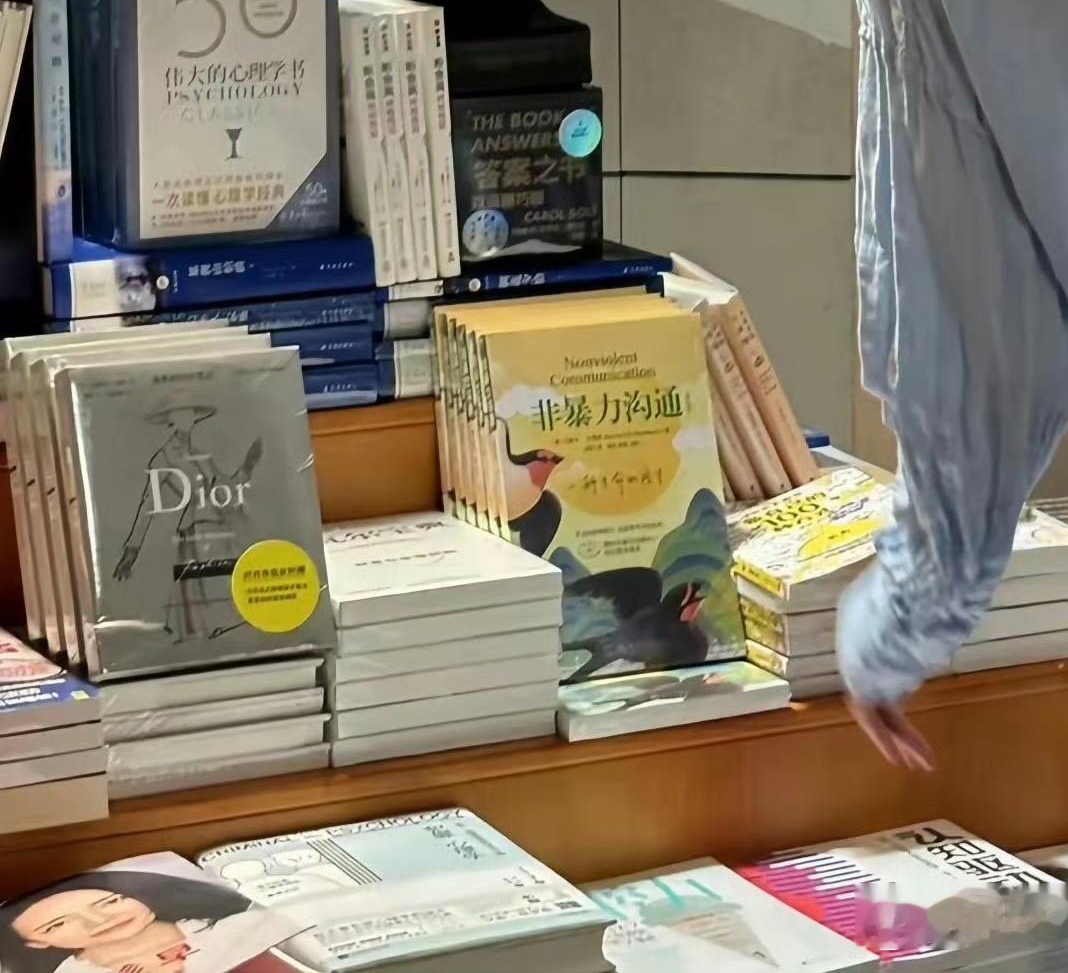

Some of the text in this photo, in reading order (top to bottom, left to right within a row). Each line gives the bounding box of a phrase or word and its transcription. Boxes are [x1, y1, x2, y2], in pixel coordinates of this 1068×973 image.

[165, 59, 305, 88] 伟大的心理学书
[530, 385, 684, 432] 非暴力沟通
[144, 468, 250, 515] Dior
